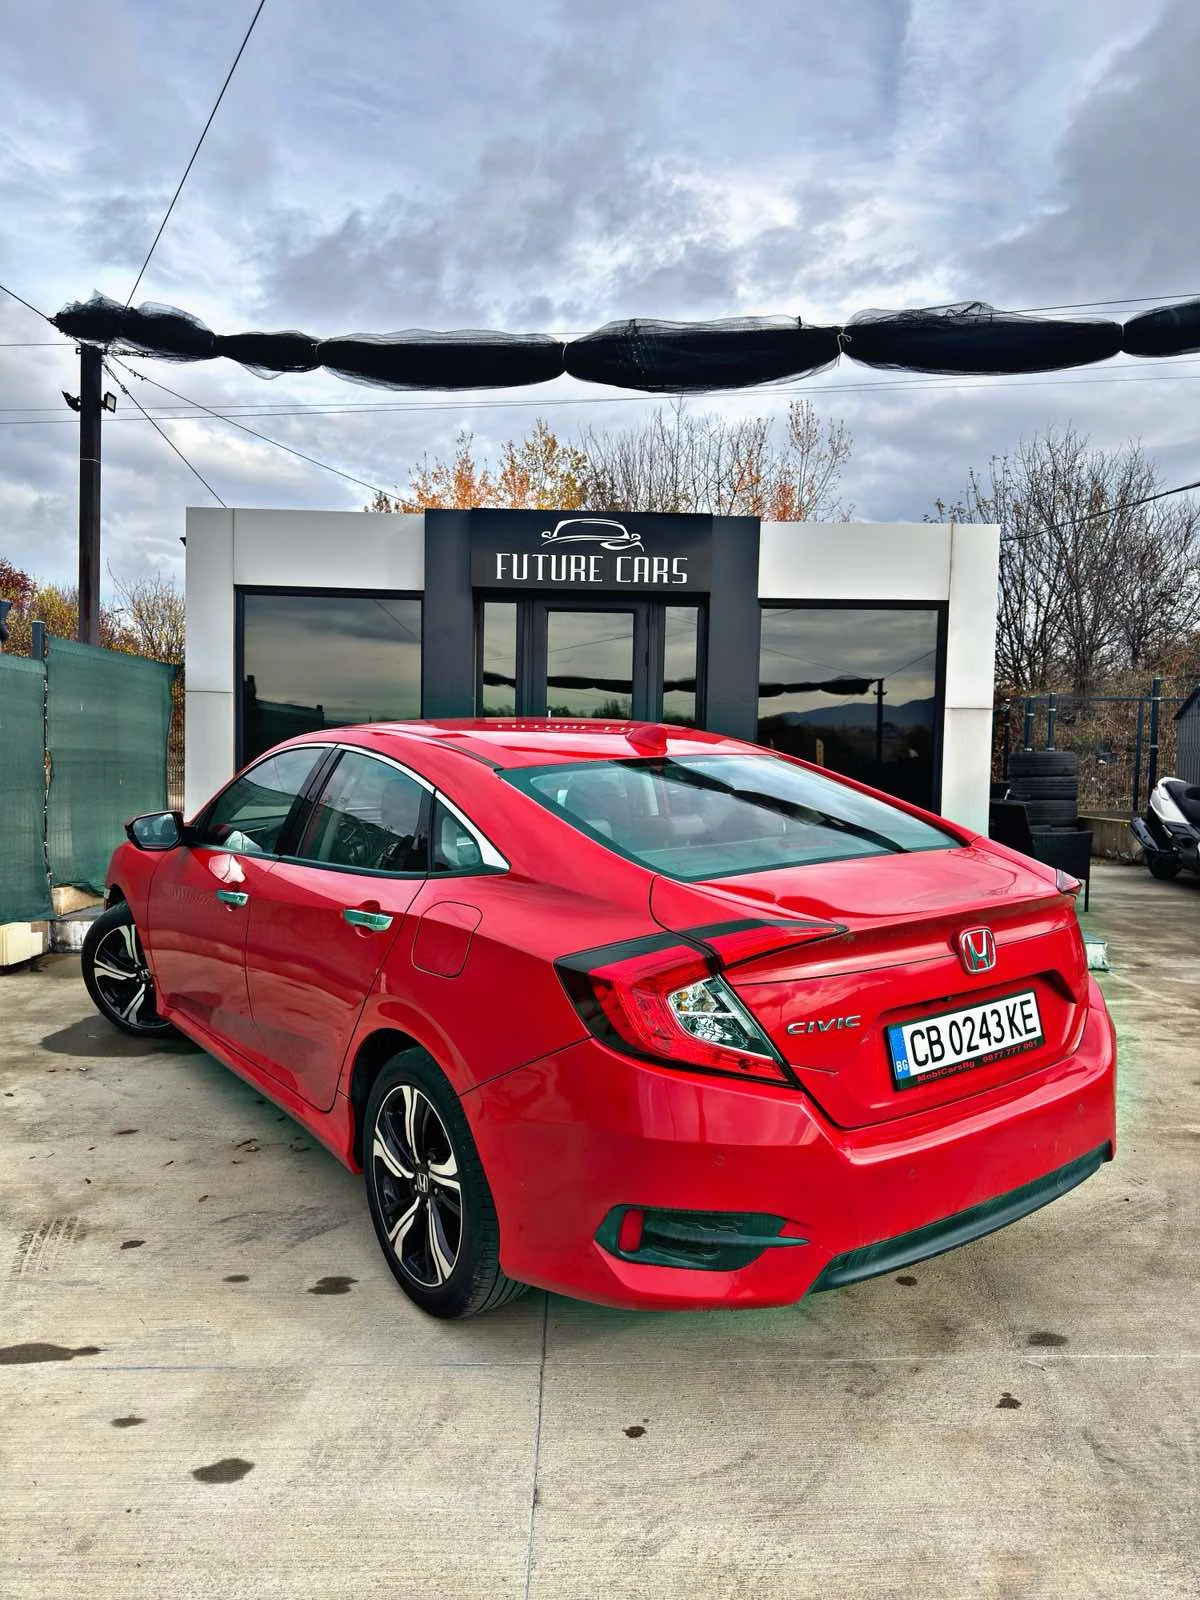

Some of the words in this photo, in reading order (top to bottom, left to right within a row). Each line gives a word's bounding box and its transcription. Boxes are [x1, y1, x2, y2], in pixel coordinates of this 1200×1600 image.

[495, 552, 604, 583] FUTURE
[616, 556, 688, 584] CARS
[787, 1015, 861, 1035] CIVIC
[910, 1025, 945, 1067] CB
[949, 1009, 1005, 1056] 0243
[1006, 999, 1037, 1040] KE
[896, 1060, 909, 1073] BG
